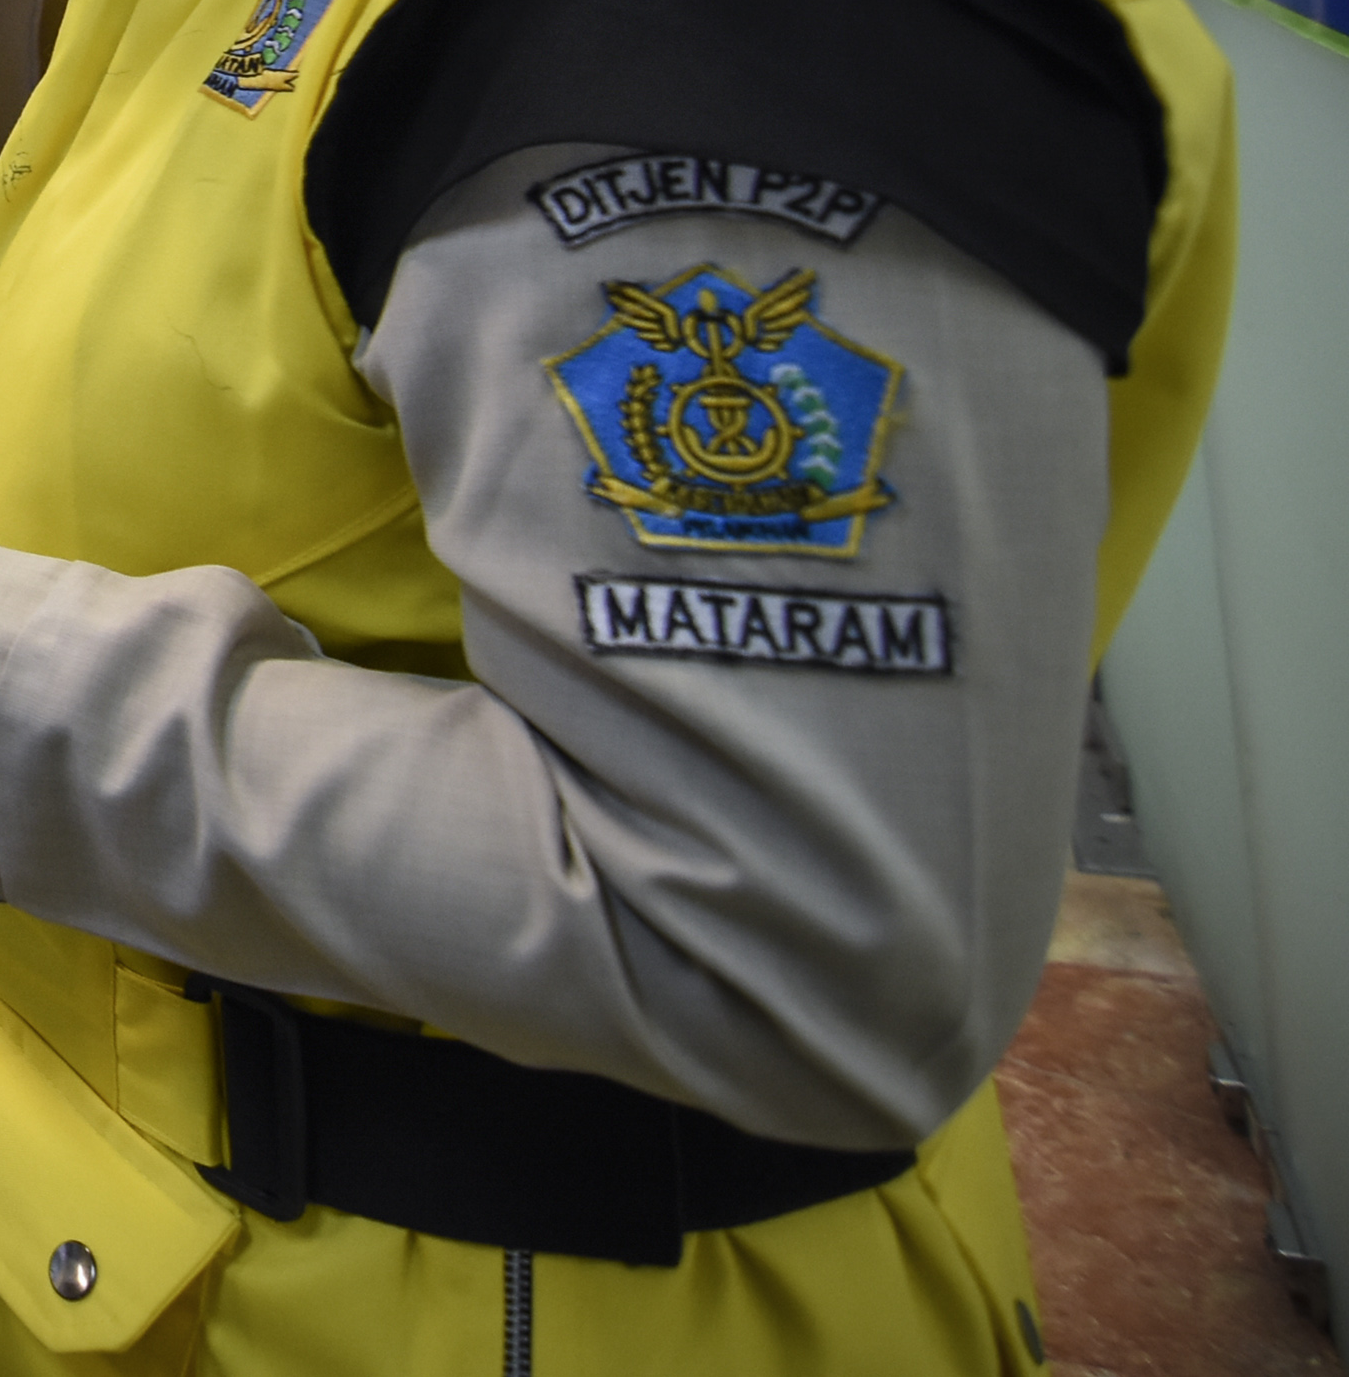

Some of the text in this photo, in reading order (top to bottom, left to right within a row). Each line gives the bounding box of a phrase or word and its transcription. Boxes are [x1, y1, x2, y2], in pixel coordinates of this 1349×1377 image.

[550, 159, 865, 227] DITJEN P2P
[604, 585, 926, 664] MATARAM
